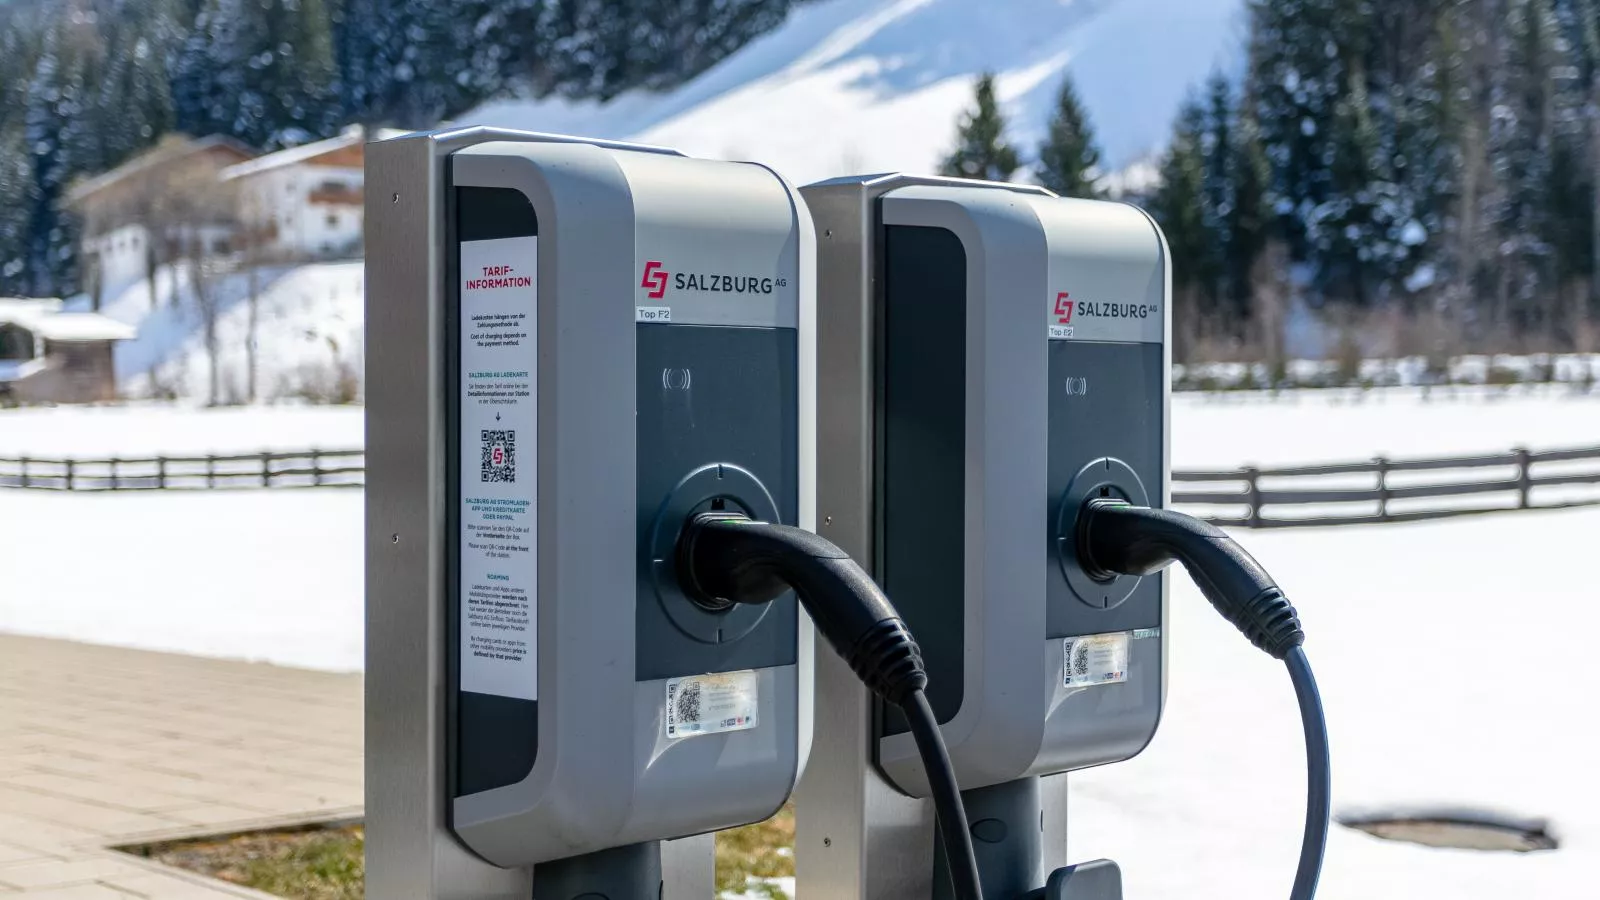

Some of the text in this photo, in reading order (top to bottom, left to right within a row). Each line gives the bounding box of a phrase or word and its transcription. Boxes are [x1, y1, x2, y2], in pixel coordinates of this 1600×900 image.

[483, 266, 514, 276] TARIF-
[466, 277, 531, 290] INFORMATION
[675, 273, 772, 294] SALZBURG
[639, 310, 669, 319] Top F2
[1078, 302, 1147, 318] SALZBURG
